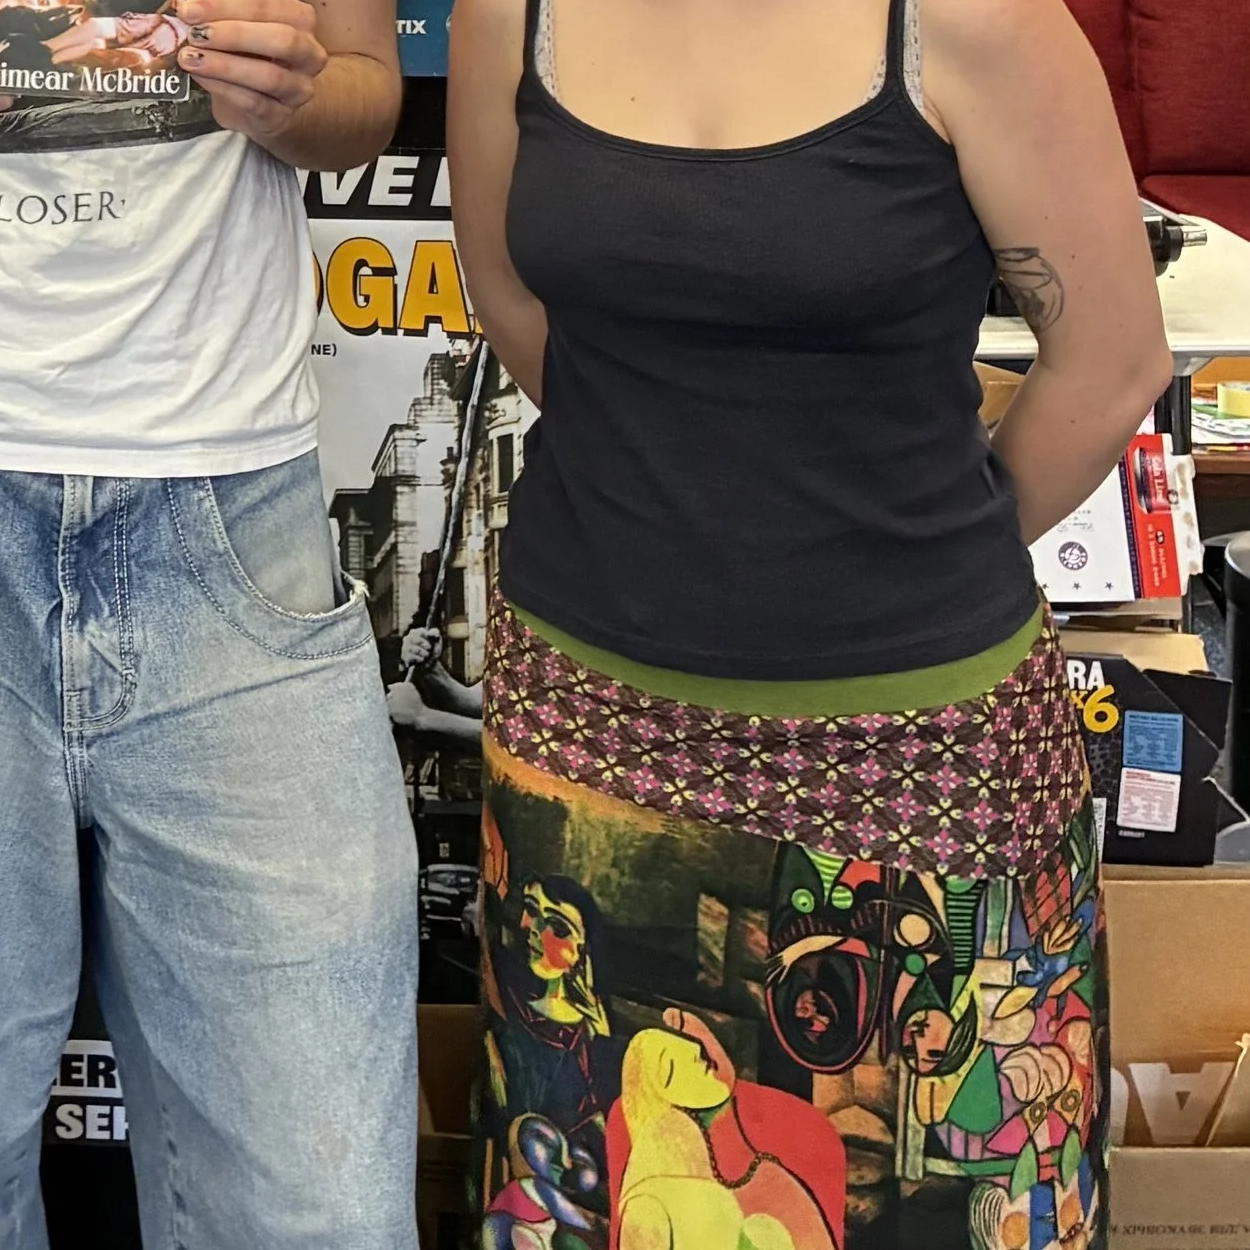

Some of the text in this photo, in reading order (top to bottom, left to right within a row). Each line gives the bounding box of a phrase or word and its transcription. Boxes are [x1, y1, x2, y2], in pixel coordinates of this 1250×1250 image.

[396, 19, 427, 35] TIX
[80, 65, 180, 96] McBride
[296, 155, 420, 206] VE
[1066, 659, 1105, 690] RA
[59, 1053, 118, 1088] ER
